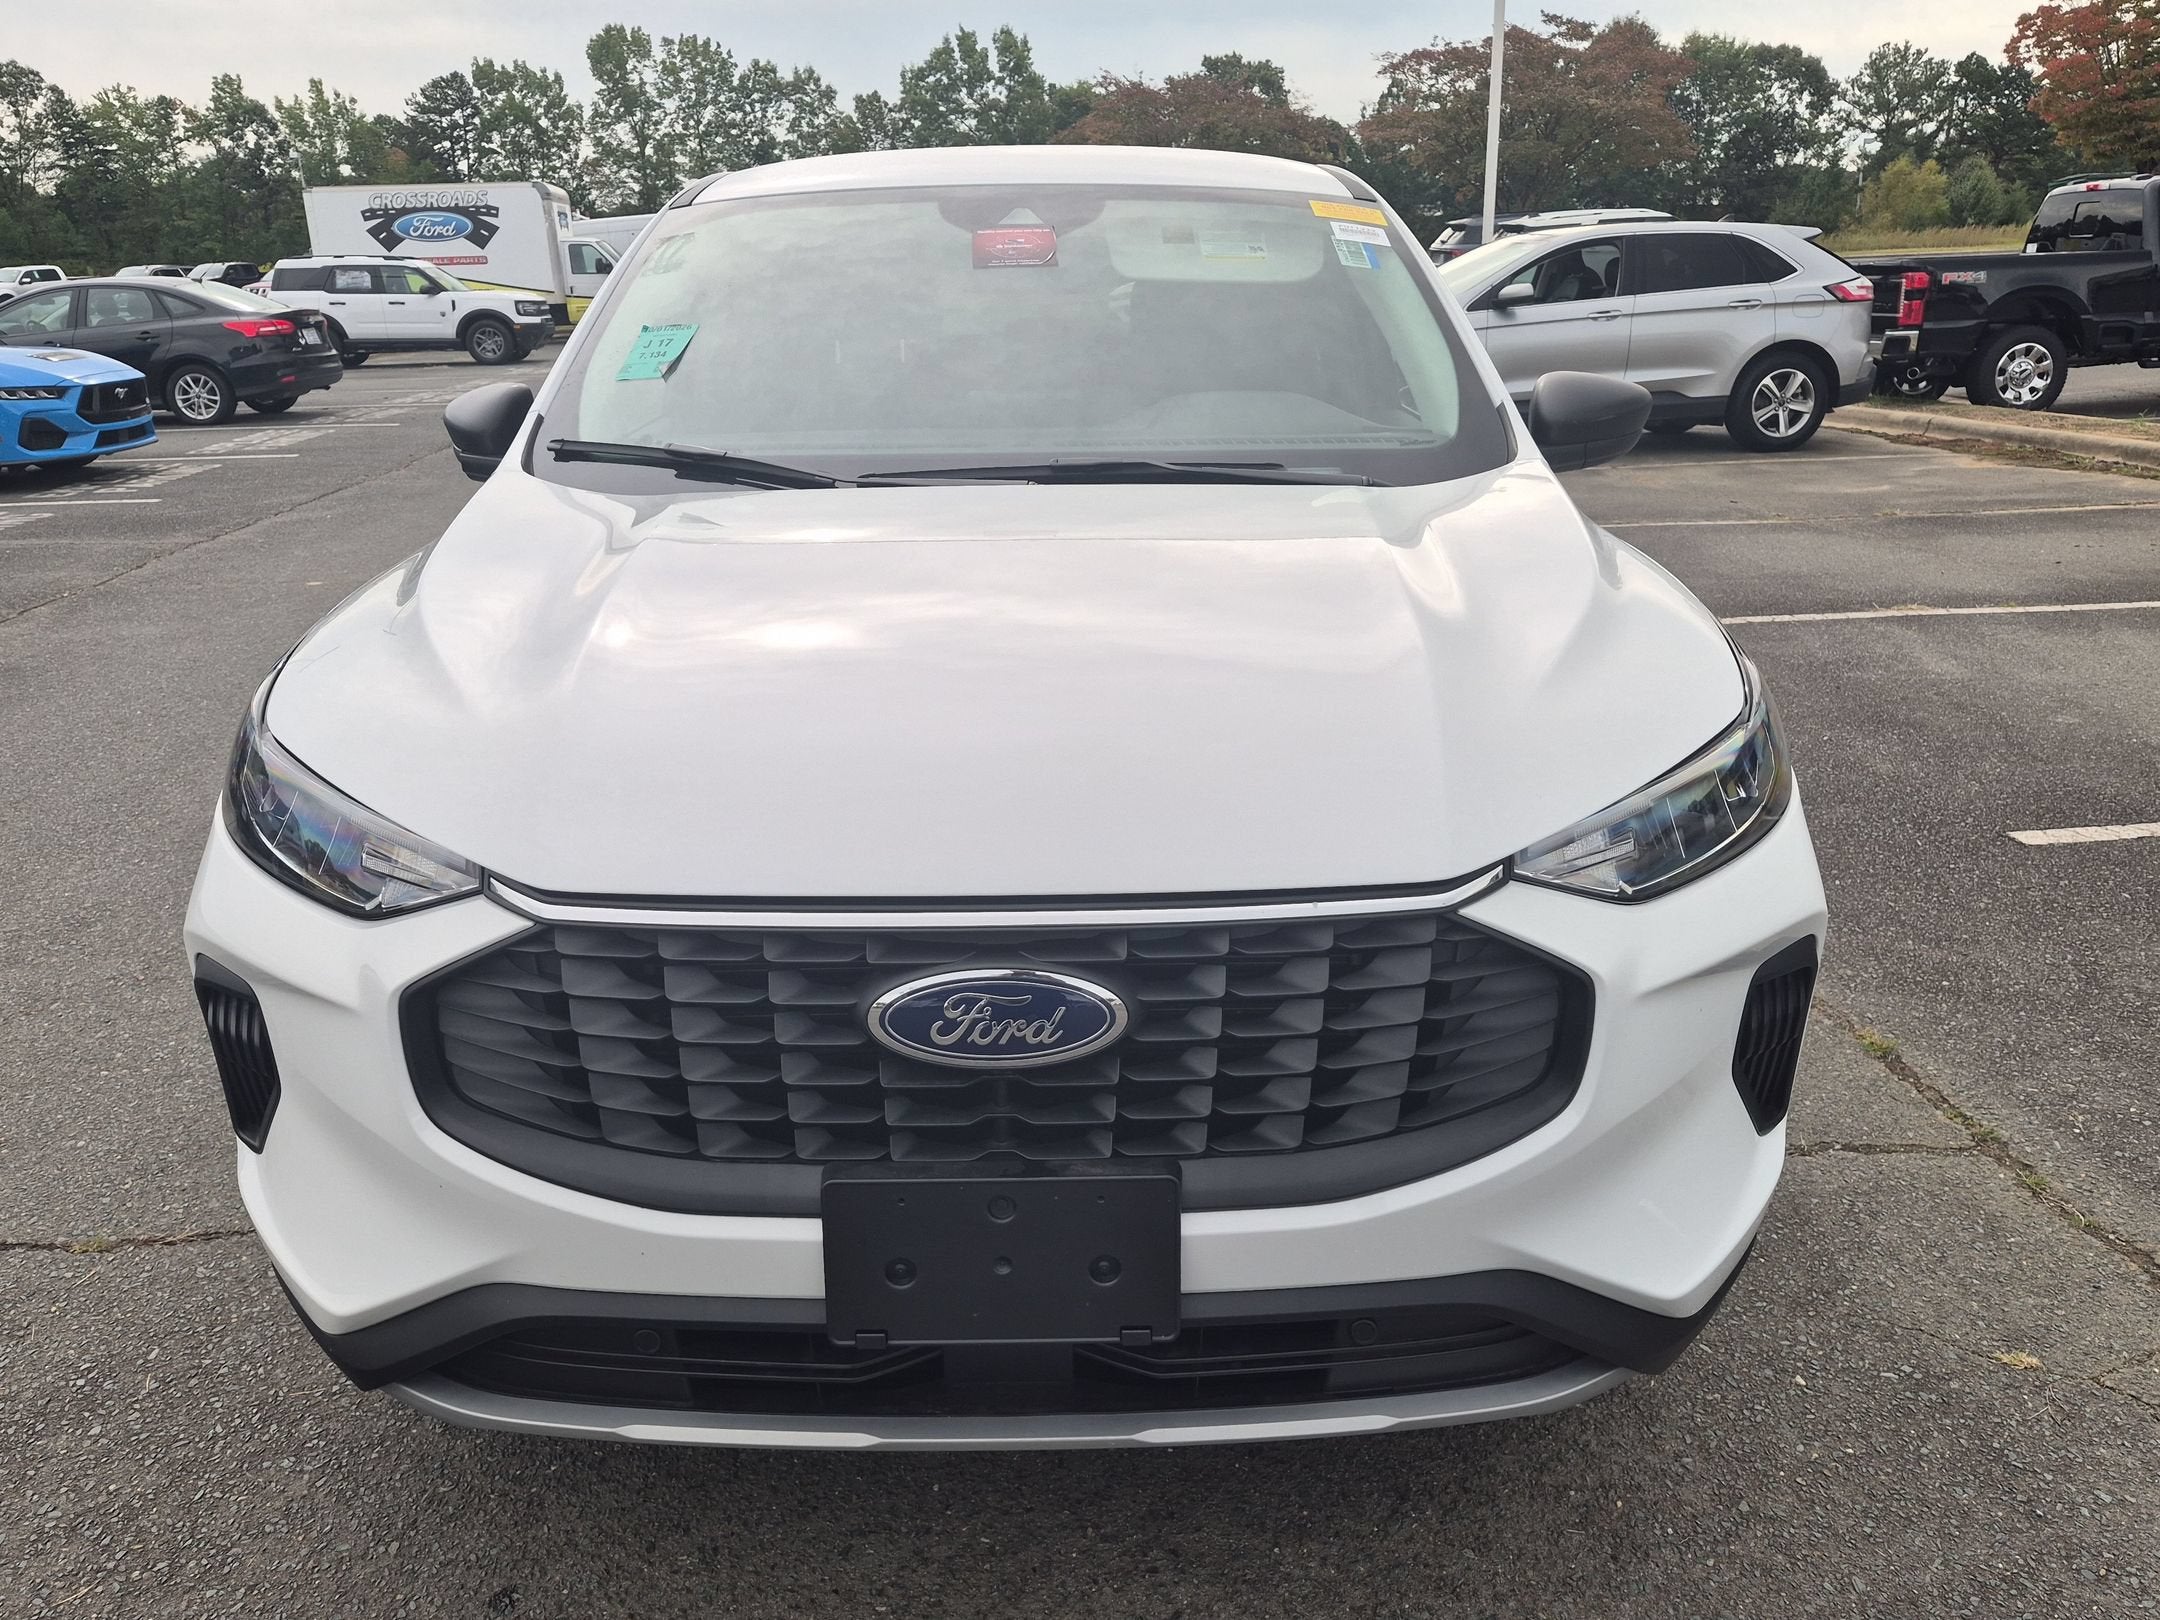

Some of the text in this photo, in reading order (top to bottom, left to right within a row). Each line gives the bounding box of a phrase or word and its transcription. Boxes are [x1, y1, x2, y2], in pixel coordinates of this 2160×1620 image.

[369, 190, 488, 209] CROSSROADS
[409, 216, 456, 237] Ford
[453, 256, 487, 264] PARTS
[658, 338, 674, 347] 17
[930, 992, 1066, 1046] Ford
